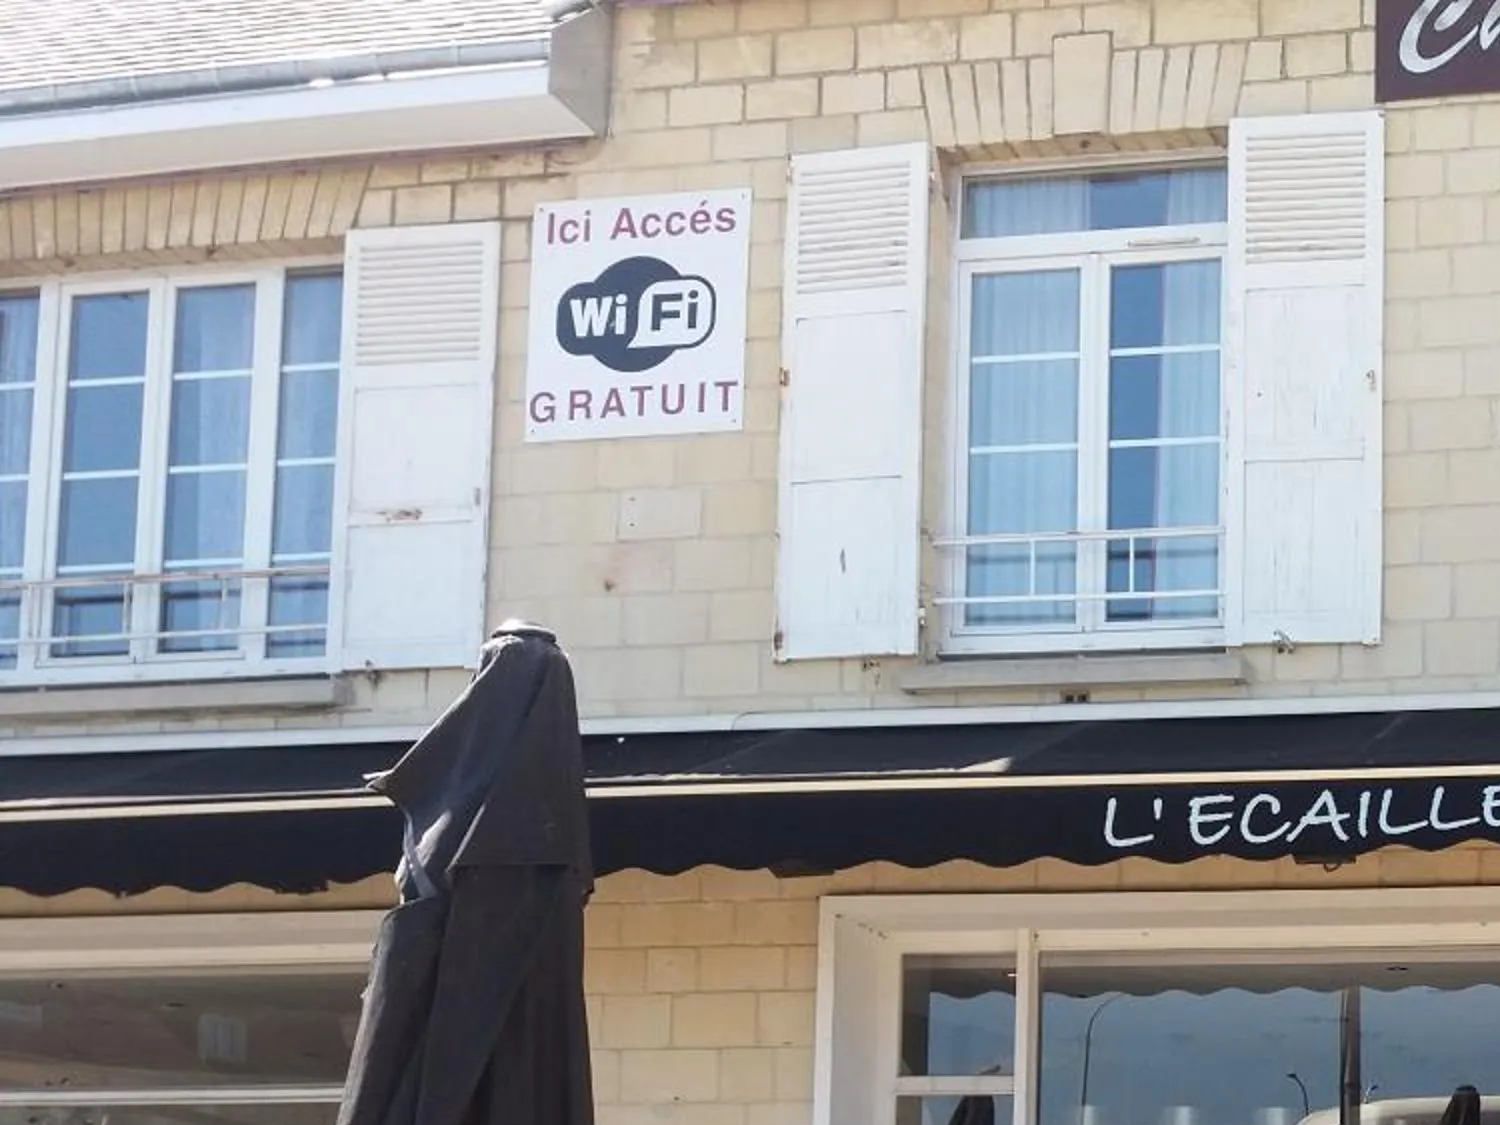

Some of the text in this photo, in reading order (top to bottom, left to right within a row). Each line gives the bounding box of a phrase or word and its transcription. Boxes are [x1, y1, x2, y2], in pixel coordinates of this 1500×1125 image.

[547, 200, 737, 244] Ici Accés
[529, 381, 738, 423] GRATUIT
